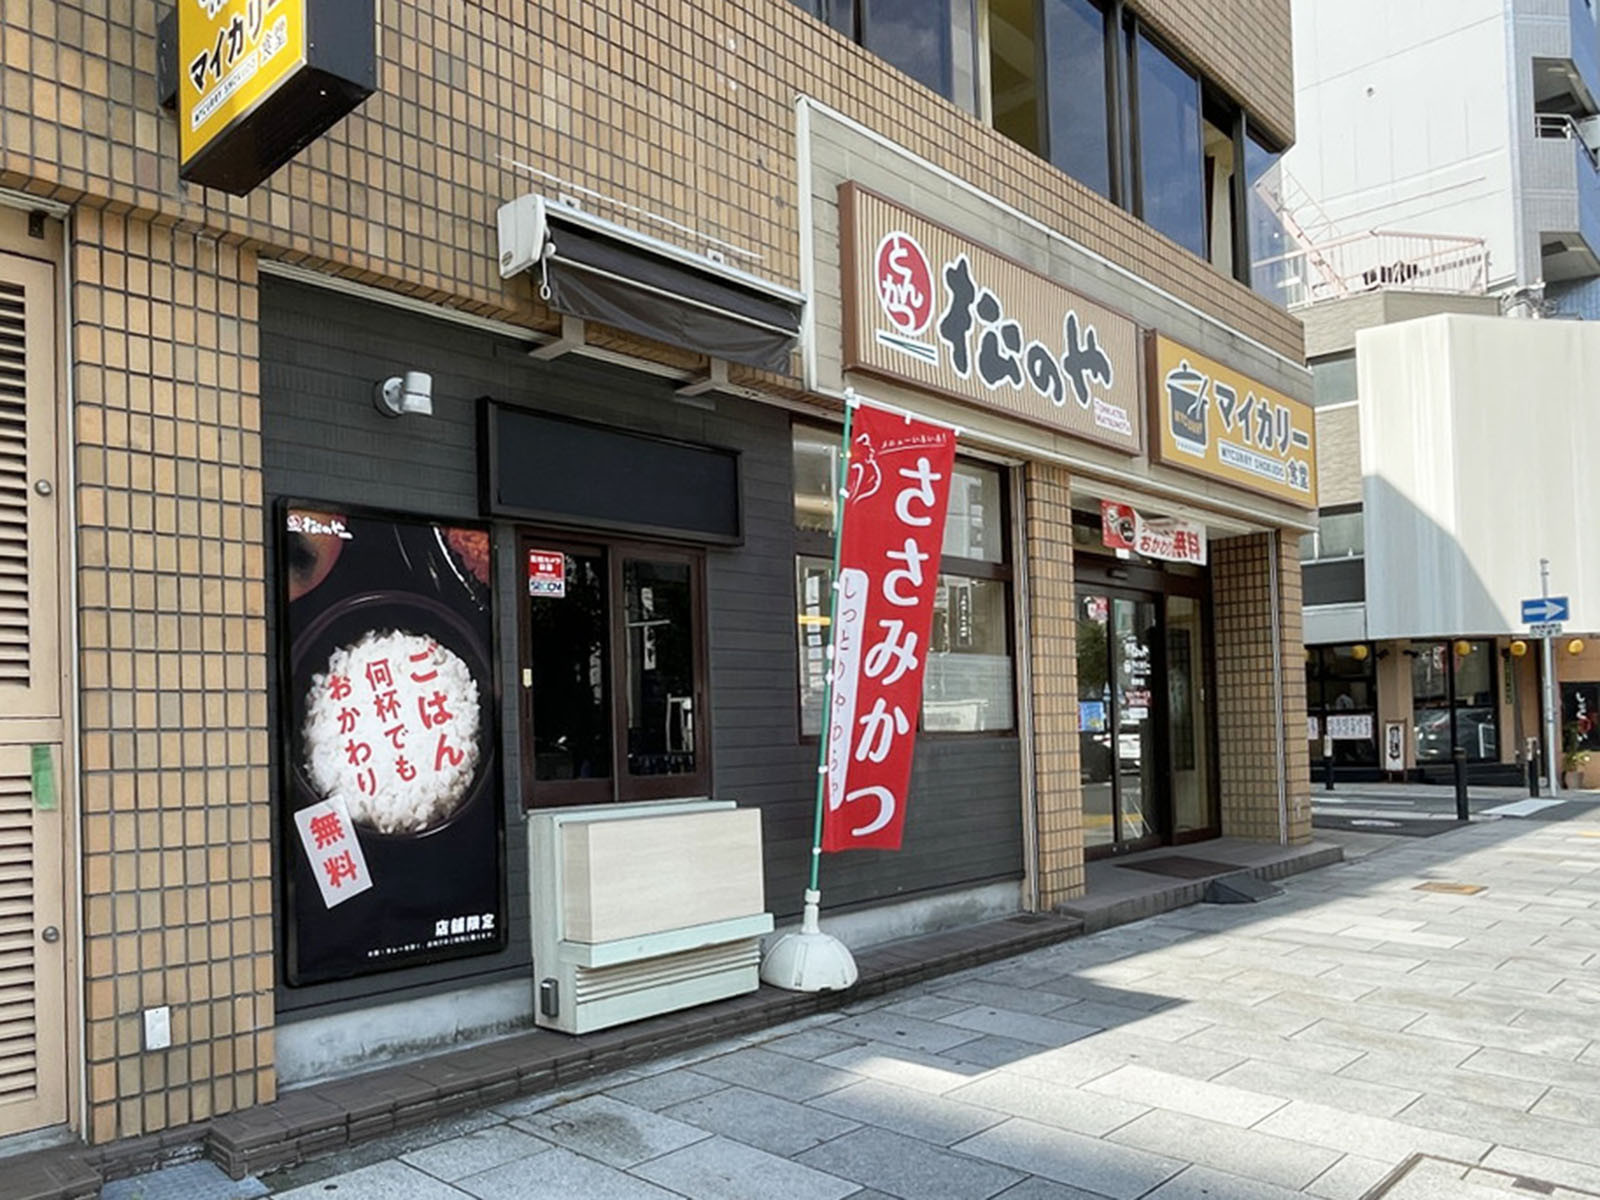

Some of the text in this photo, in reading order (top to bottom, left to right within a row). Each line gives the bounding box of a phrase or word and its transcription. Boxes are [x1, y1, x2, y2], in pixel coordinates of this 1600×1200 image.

[881, 237, 924, 333] とんかつ
[940, 256, 1112, 406] 松のや
[1214, 383, 1309, 453] マイカリー
[410, 642, 464, 771] ごはん
[845, 456, 942, 836] ささみかつ
[328, 674, 377, 796] おかわり
[365, 658, 417, 782] 何杯でも
[309, 811, 357, 888] 無料
[435, 913, 495, 937] 店舗限定
